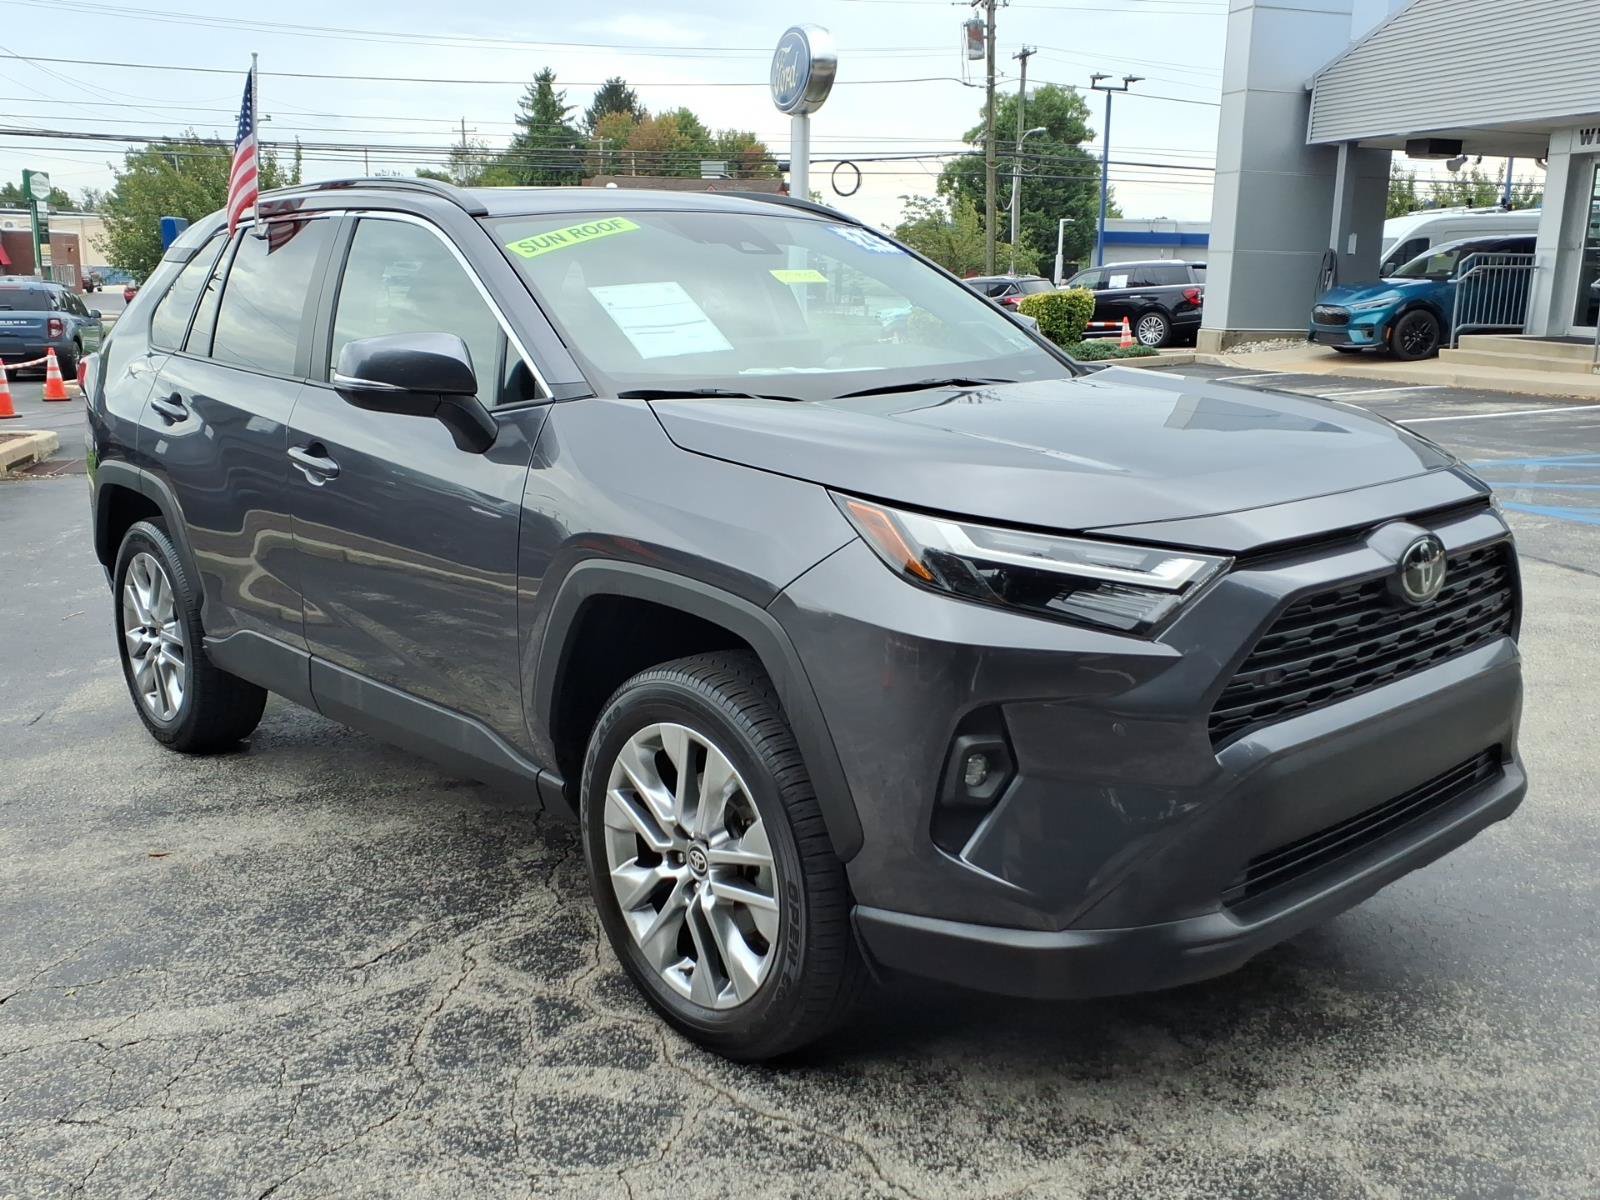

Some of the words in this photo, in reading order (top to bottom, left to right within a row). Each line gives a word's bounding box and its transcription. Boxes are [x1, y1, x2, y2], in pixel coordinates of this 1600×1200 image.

[774, 44, 800, 96] Ford
[517, 233, 568, 254] SUN
[567, 218, 626, 239] ROOF
